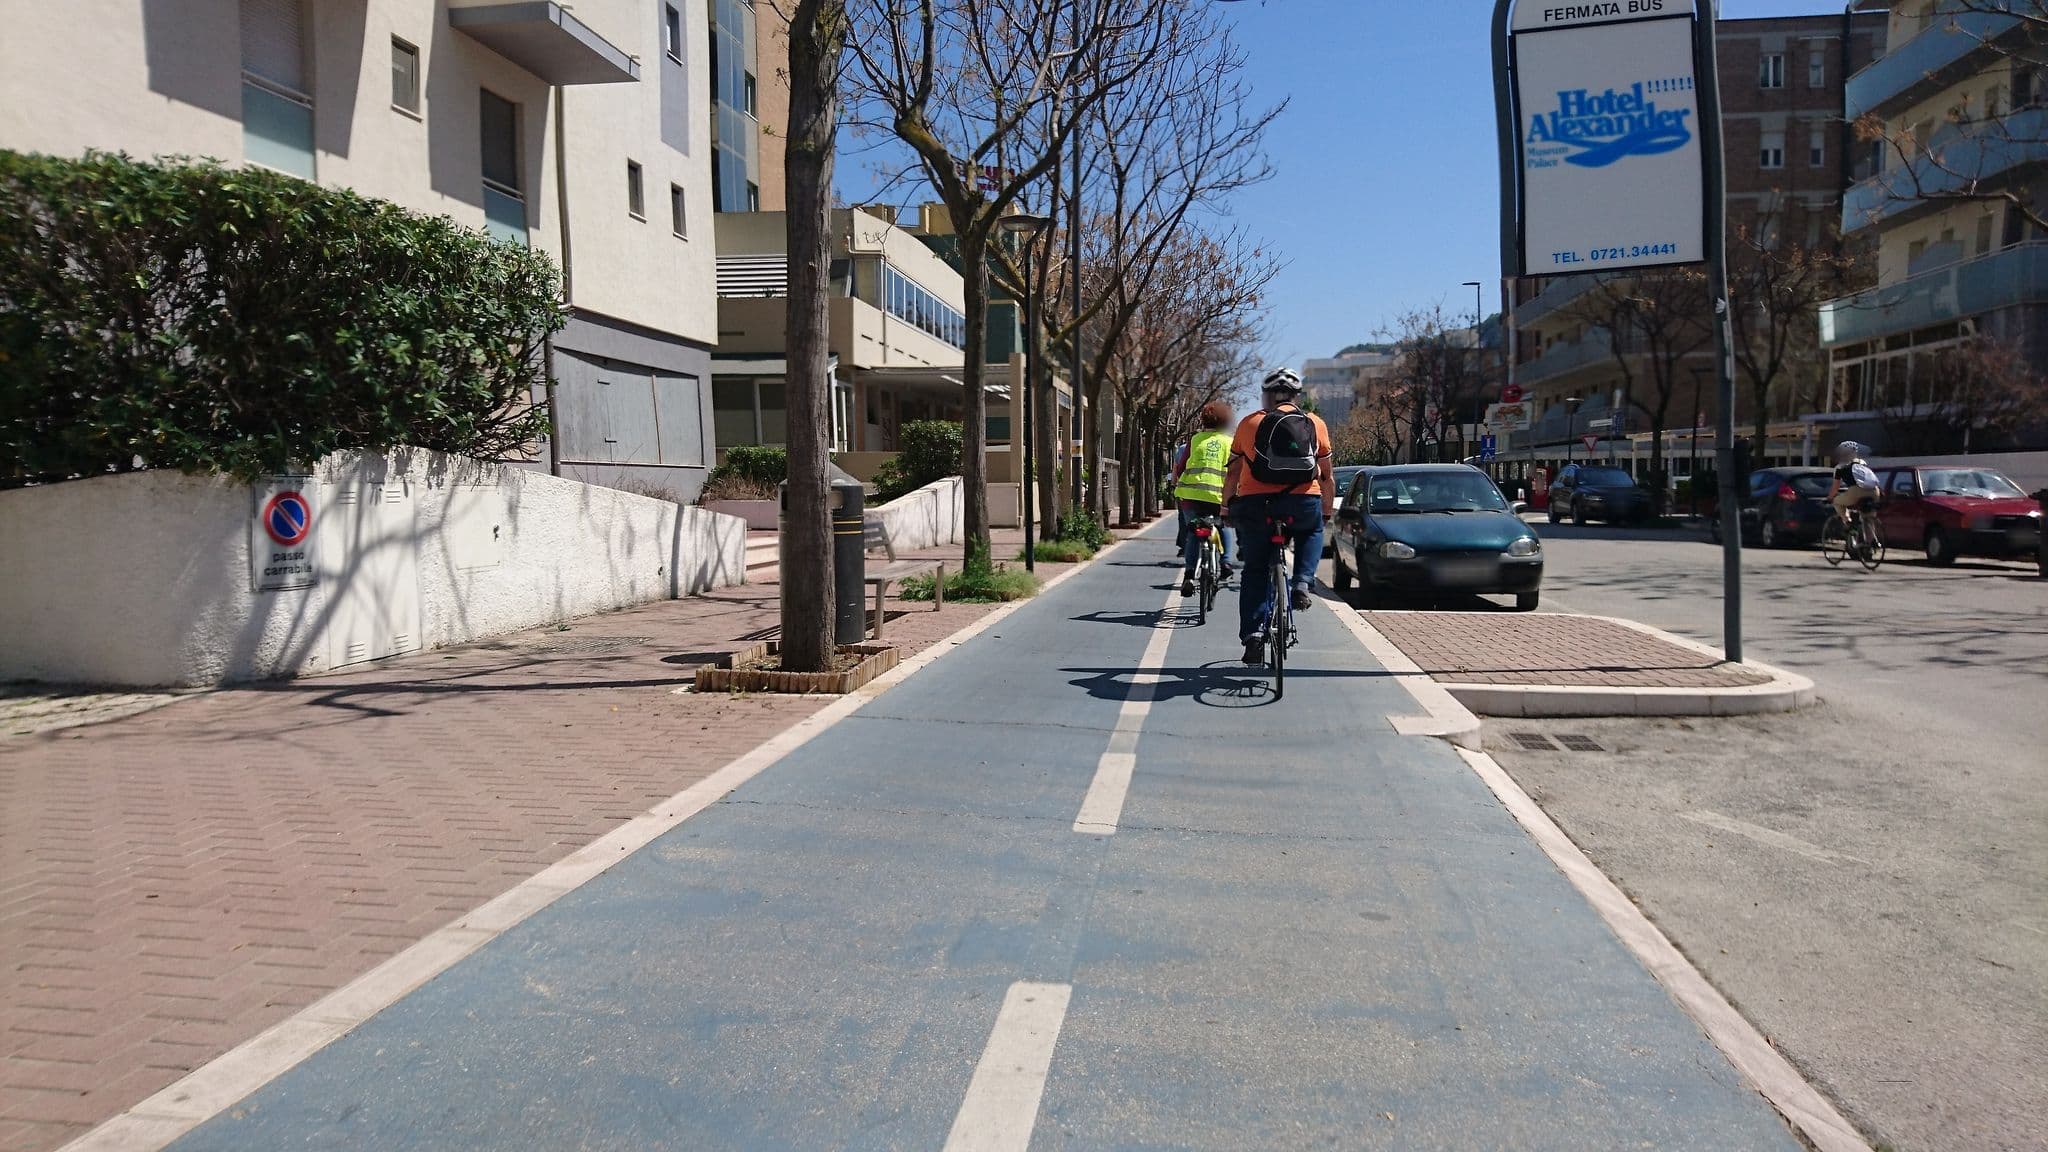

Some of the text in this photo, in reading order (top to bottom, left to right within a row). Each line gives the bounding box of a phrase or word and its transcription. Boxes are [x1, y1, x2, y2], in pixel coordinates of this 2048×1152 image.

[1544, 0, 1663, 22] FERMATA BUS
[1557, 81, 1644, 119] Hotel
[1526, 101, 1691, 143] Alexander
[1552, 243, 1677, 264] TEL. 0721.34441
[272, 551, 304, 563] passo
[264, 562, 312, 576] carrabile
